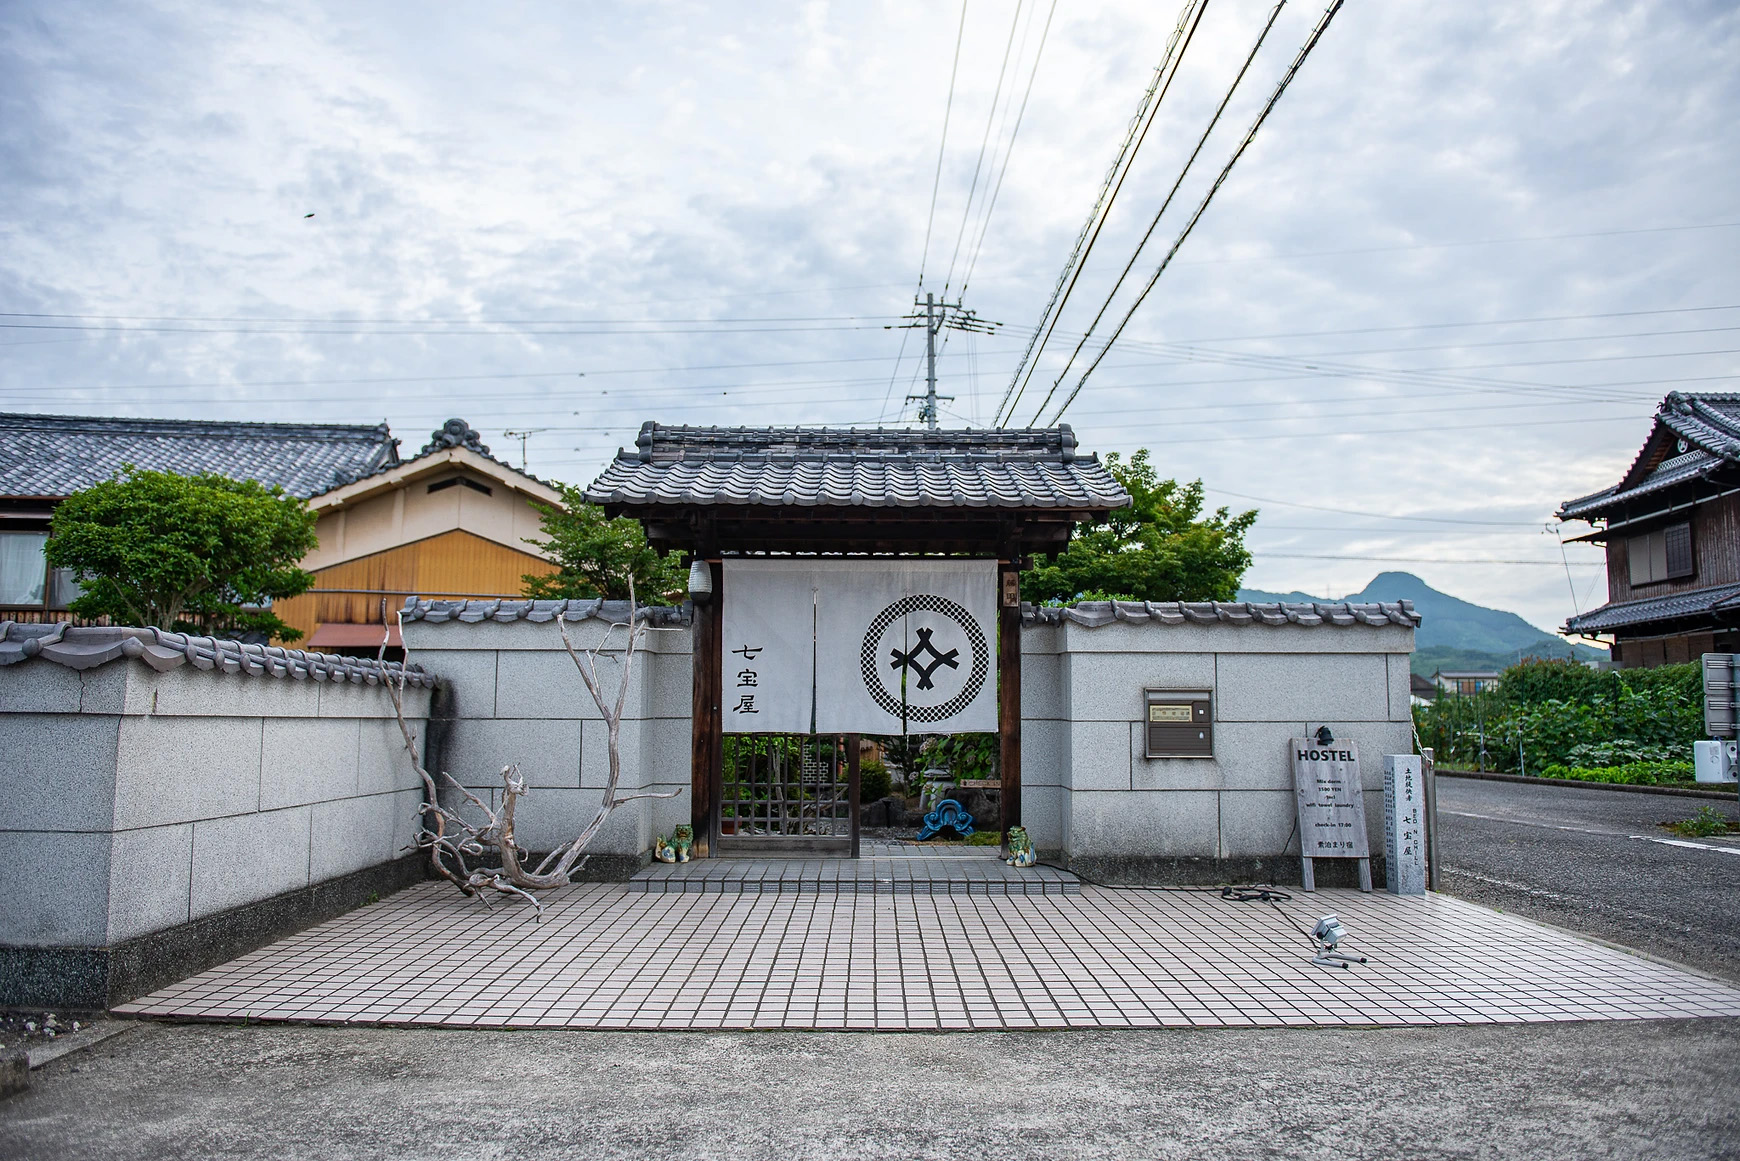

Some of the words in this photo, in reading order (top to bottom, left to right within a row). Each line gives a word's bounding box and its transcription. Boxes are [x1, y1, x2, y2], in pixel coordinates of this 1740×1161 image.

[731, 644, 764, 715] 七宝屋
[1297, 749, 1355, 762] HOSTEL
[1402, 815, 1412, 856] 七宝屋
